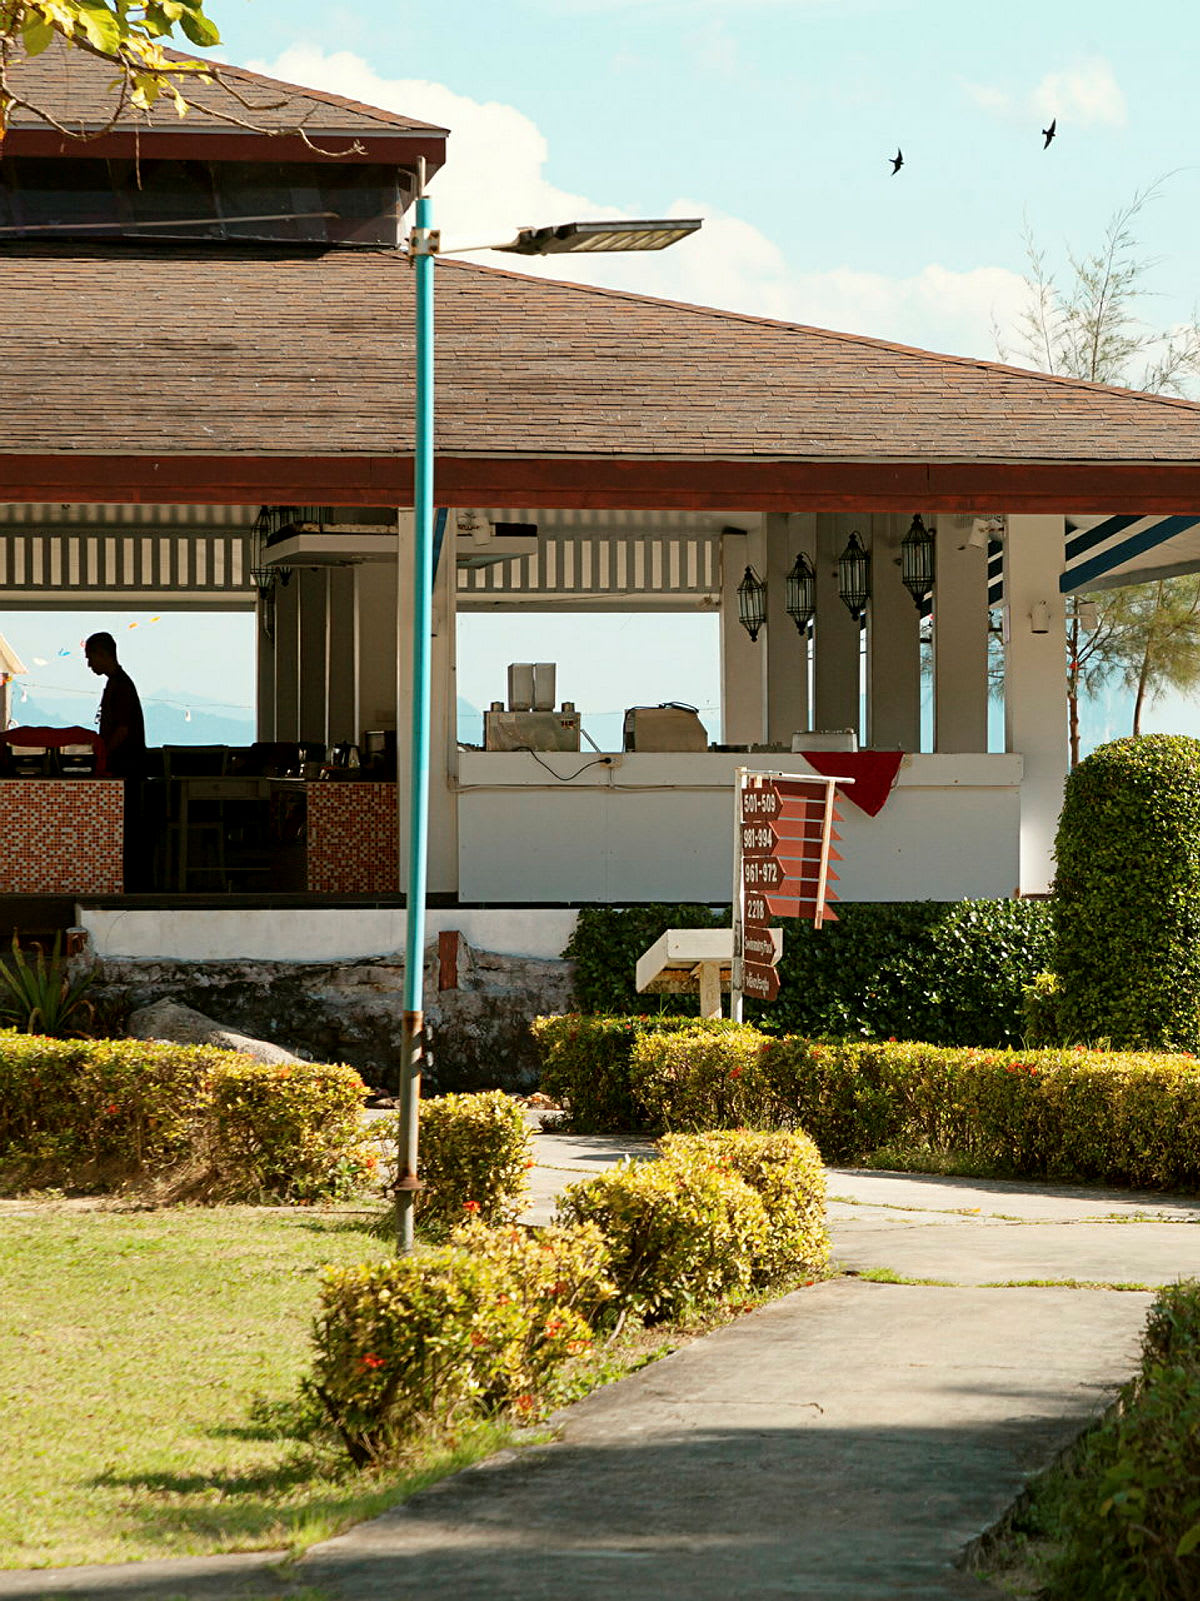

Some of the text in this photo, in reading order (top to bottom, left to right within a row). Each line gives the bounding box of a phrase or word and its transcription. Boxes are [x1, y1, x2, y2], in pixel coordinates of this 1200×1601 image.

[744, 793, 776, 813] 501-509
[743, 828, 773, 848] 981-994
[744, 862, 778, 883] 961-972
